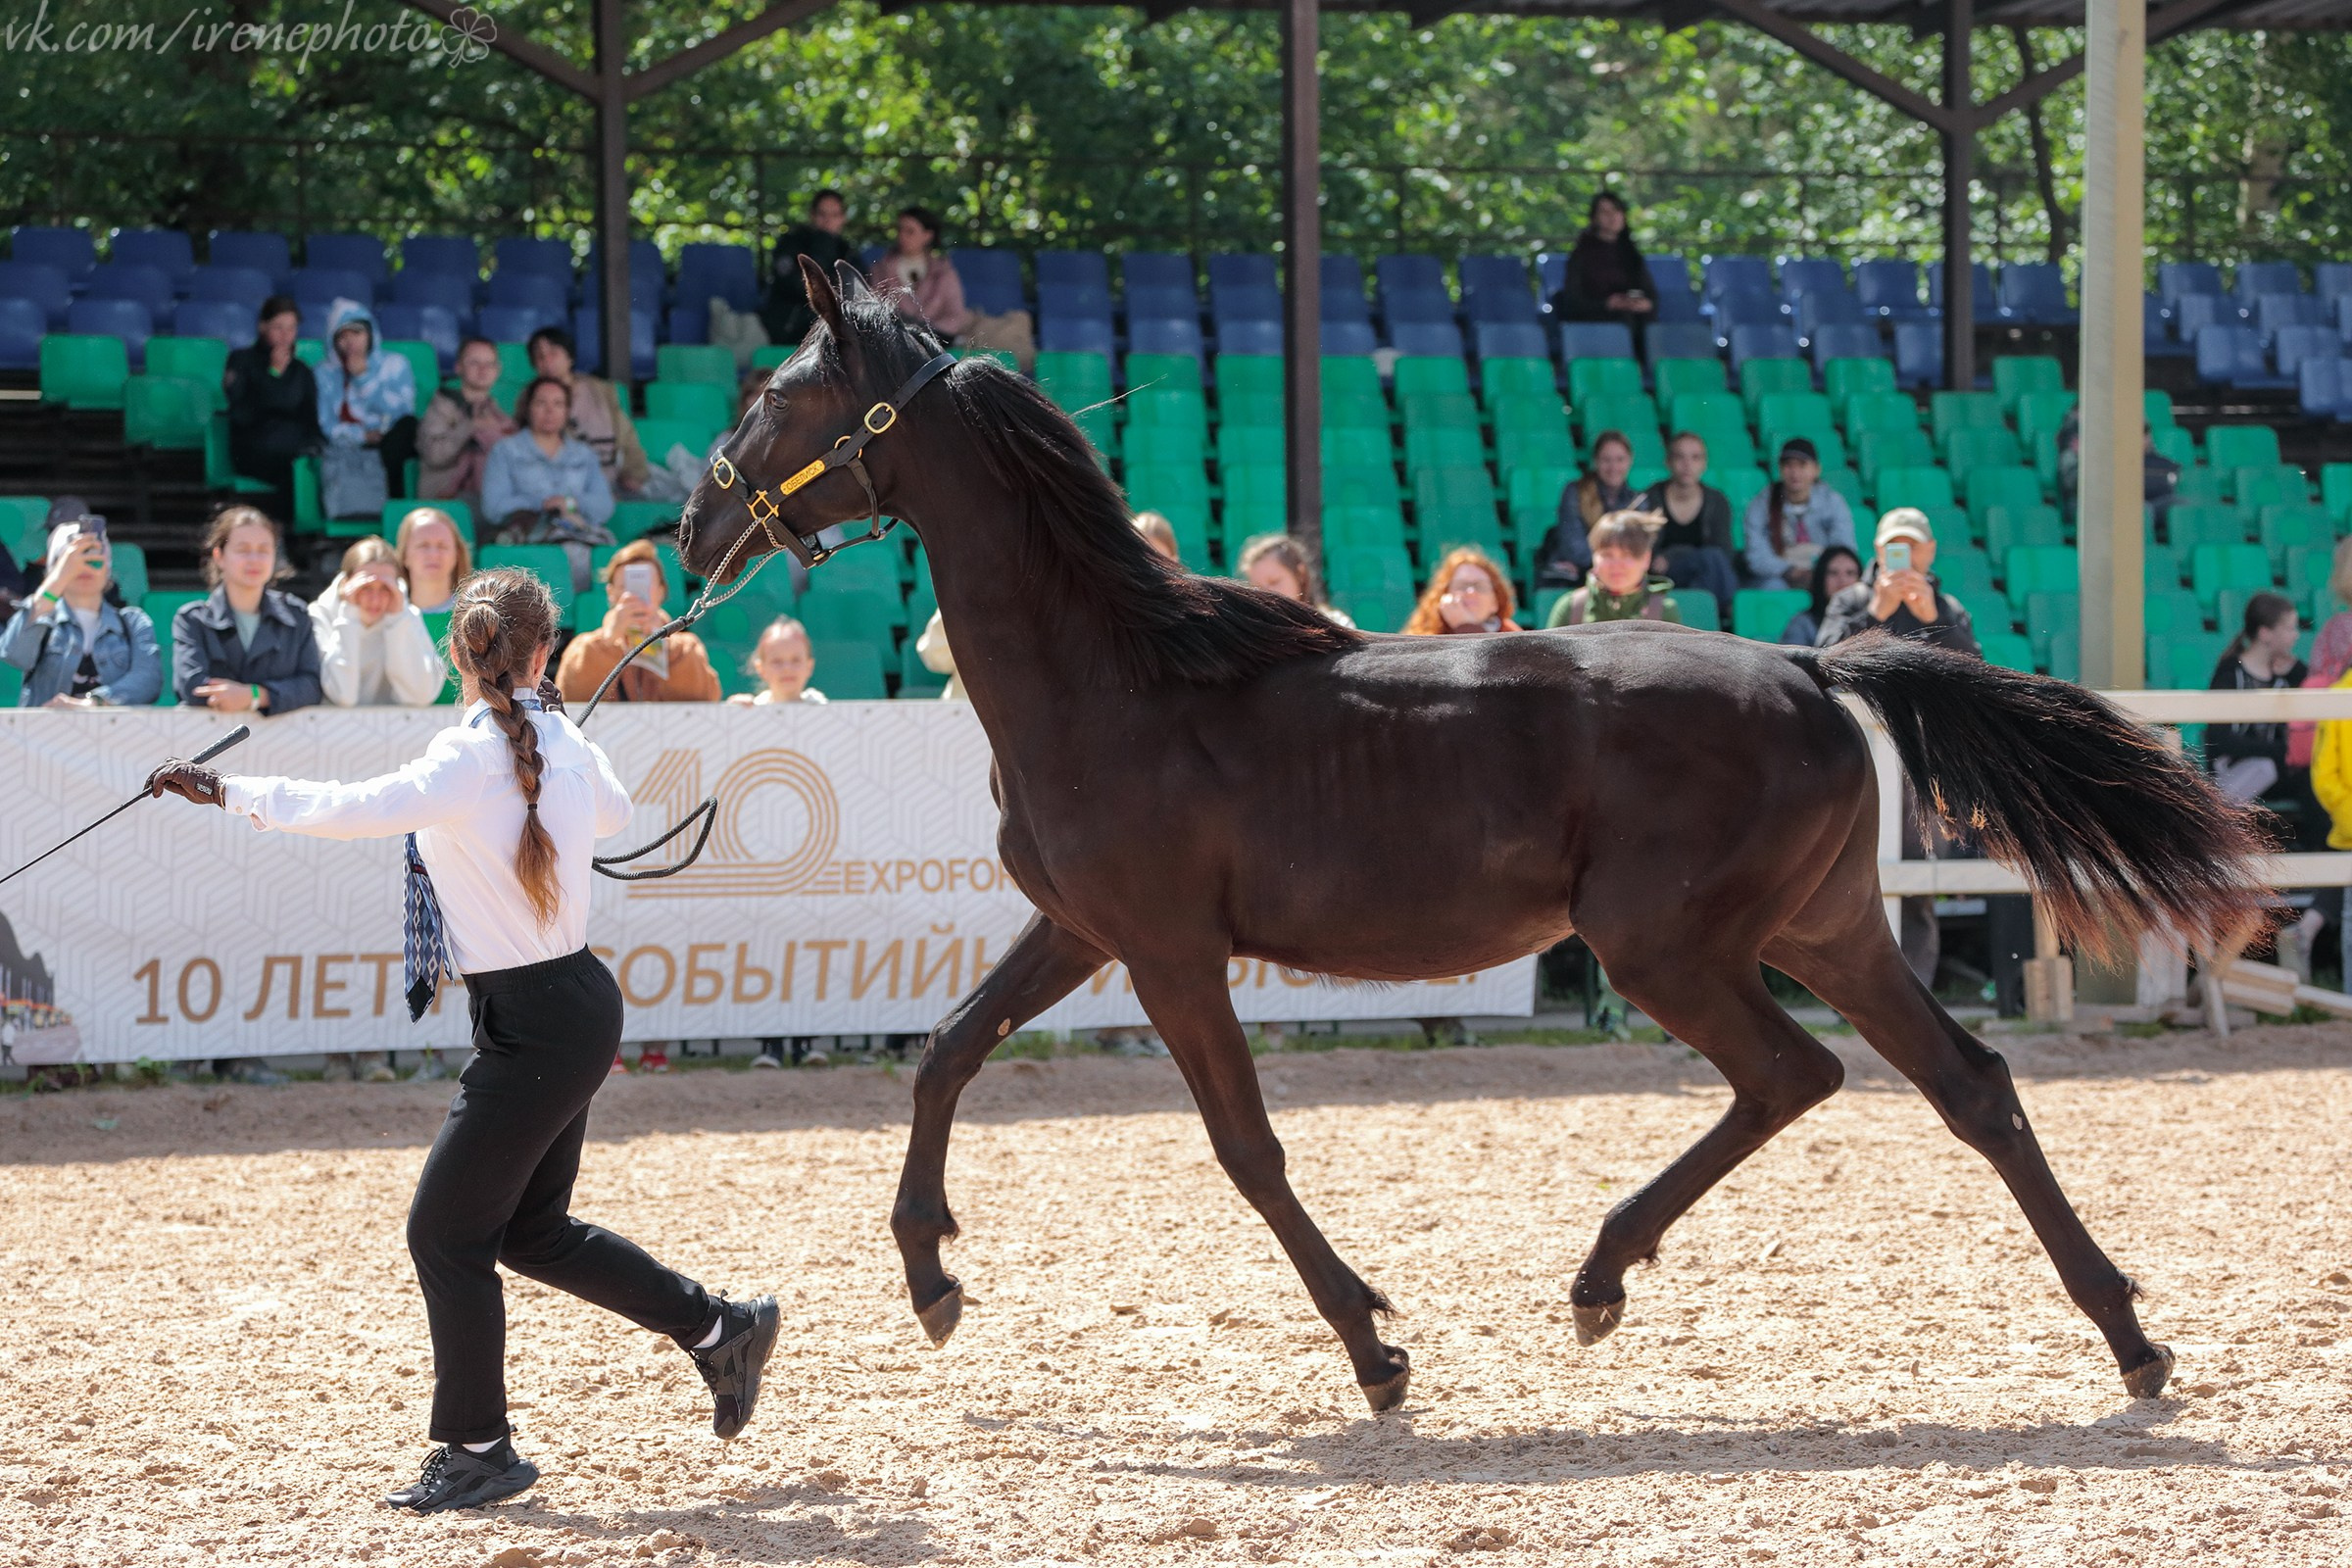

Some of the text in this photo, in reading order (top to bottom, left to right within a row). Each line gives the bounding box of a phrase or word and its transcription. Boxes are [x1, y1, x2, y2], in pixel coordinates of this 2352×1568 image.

[786, 463, 820, 492] ОБЕЛИСК
[133, 957, 222, 1025] 10
[244, 953, 405, 1020] ЛЕТ
